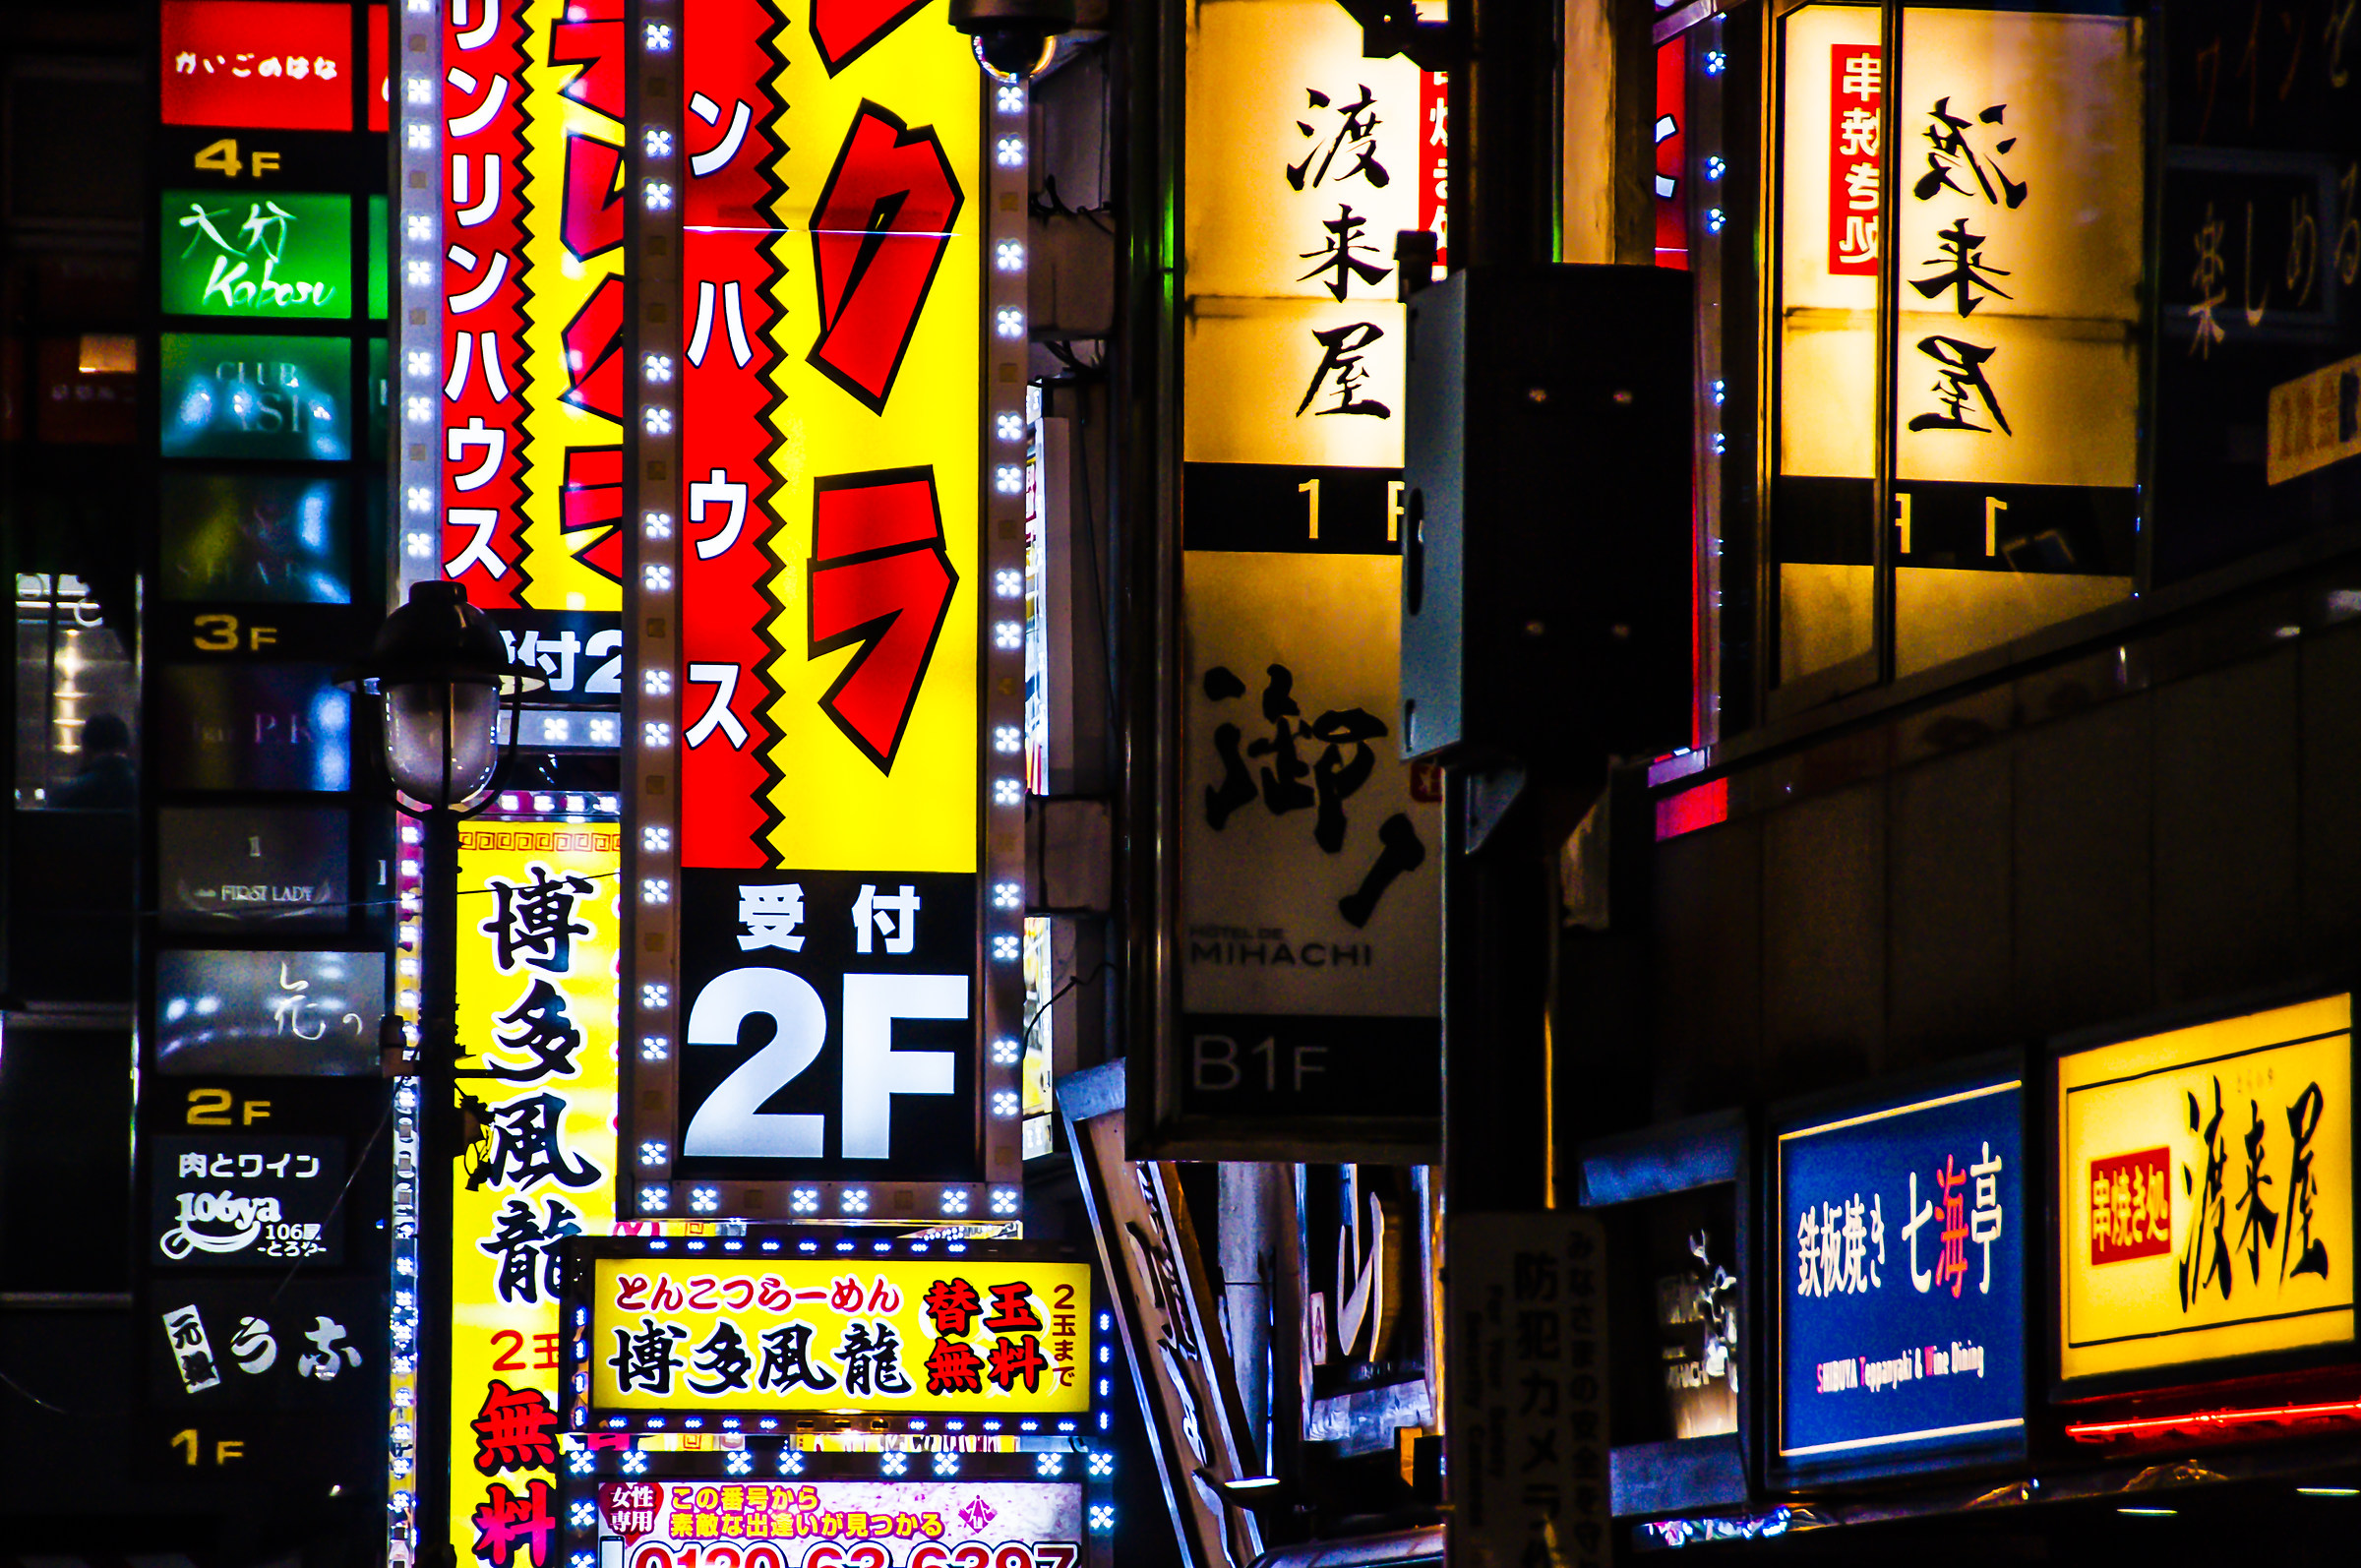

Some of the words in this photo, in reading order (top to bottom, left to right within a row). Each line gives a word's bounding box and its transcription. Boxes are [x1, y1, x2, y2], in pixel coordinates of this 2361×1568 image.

[195, 139, 280, 178] 4F
[1287, 84, 1394, 420] 渡来屋
[202, 255, 335, 308] Kabosu
[444, 0, 510, 580] リンリンハウス
[194, 615, 277, 651] 3F
[221, 885, 268, 901] FIRST
[272, 886, 314, 901] LADY
[736, 883, 921, 953] 受付
[1190, 941, 1372, 966] MIHACHI
[684, 967, 969, 1160] 2F
[1193, 1034, 1329, 1092] B1F
[187, 1088, 272, 1125] 2F
[179, 1152, 320, 1177] 肉とワイン
[175, 1190, 282, 1230] 106ya
[1797, 1192, 1885, 1297] 鉄板焼き
[1902, 1141, 2003, 1298] 七海亭
[2092, 1163, 2169, 1252] 串焼き処
[2179, 1075, 2329, 1313] 渡来屋
[617, 1277, 900, 1311] とんこつらーめん
[923, 1277, 1044, 1337] 替玉
[608, 1318, 913, 1395] 博多風龍
[1052, 1284, 1076, 1387] 2玉まで
[923, 1334, 1049, 1397] 無料
[171, 1429, 244, 1466] 1F
[471, 1380, 558, 1568] 無料
[611, 1511, 653, 1533] 専用
[612, 1486, 654, 1508] 女性
[672, 1486, 818, 1511] この番号から
[670, 1512, 944, 1538] 素敵な出逢いが見つかる
